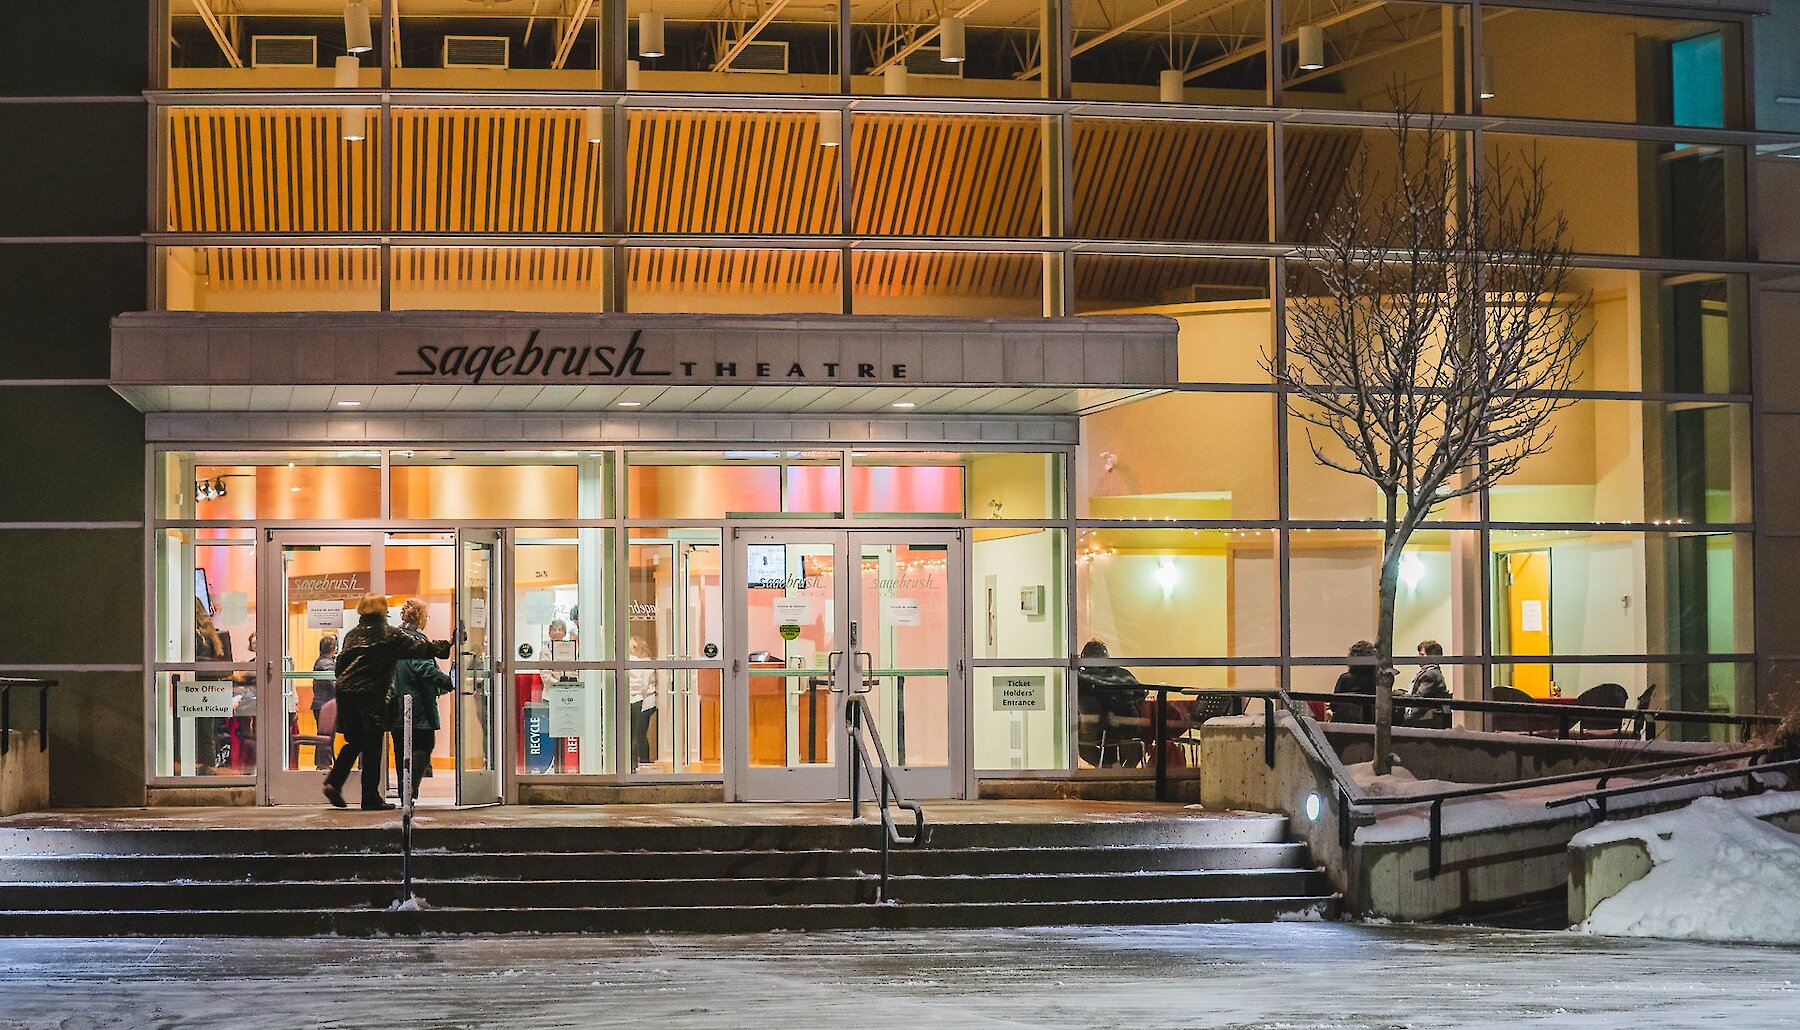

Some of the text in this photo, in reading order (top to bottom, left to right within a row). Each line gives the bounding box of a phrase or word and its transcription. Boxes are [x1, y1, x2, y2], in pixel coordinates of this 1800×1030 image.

[396, 329, 907, 384] sagebrush THEATRE
[290, 573, 364, 592] sagebrush
[869, 574, 940, 592] sagebrush
[201, 685, 225, 693] Office
[205, 705, 229, 713] Pickup
[531, 717, 541, 755] RECYCLE
[567, 736, 578, 753] REF
